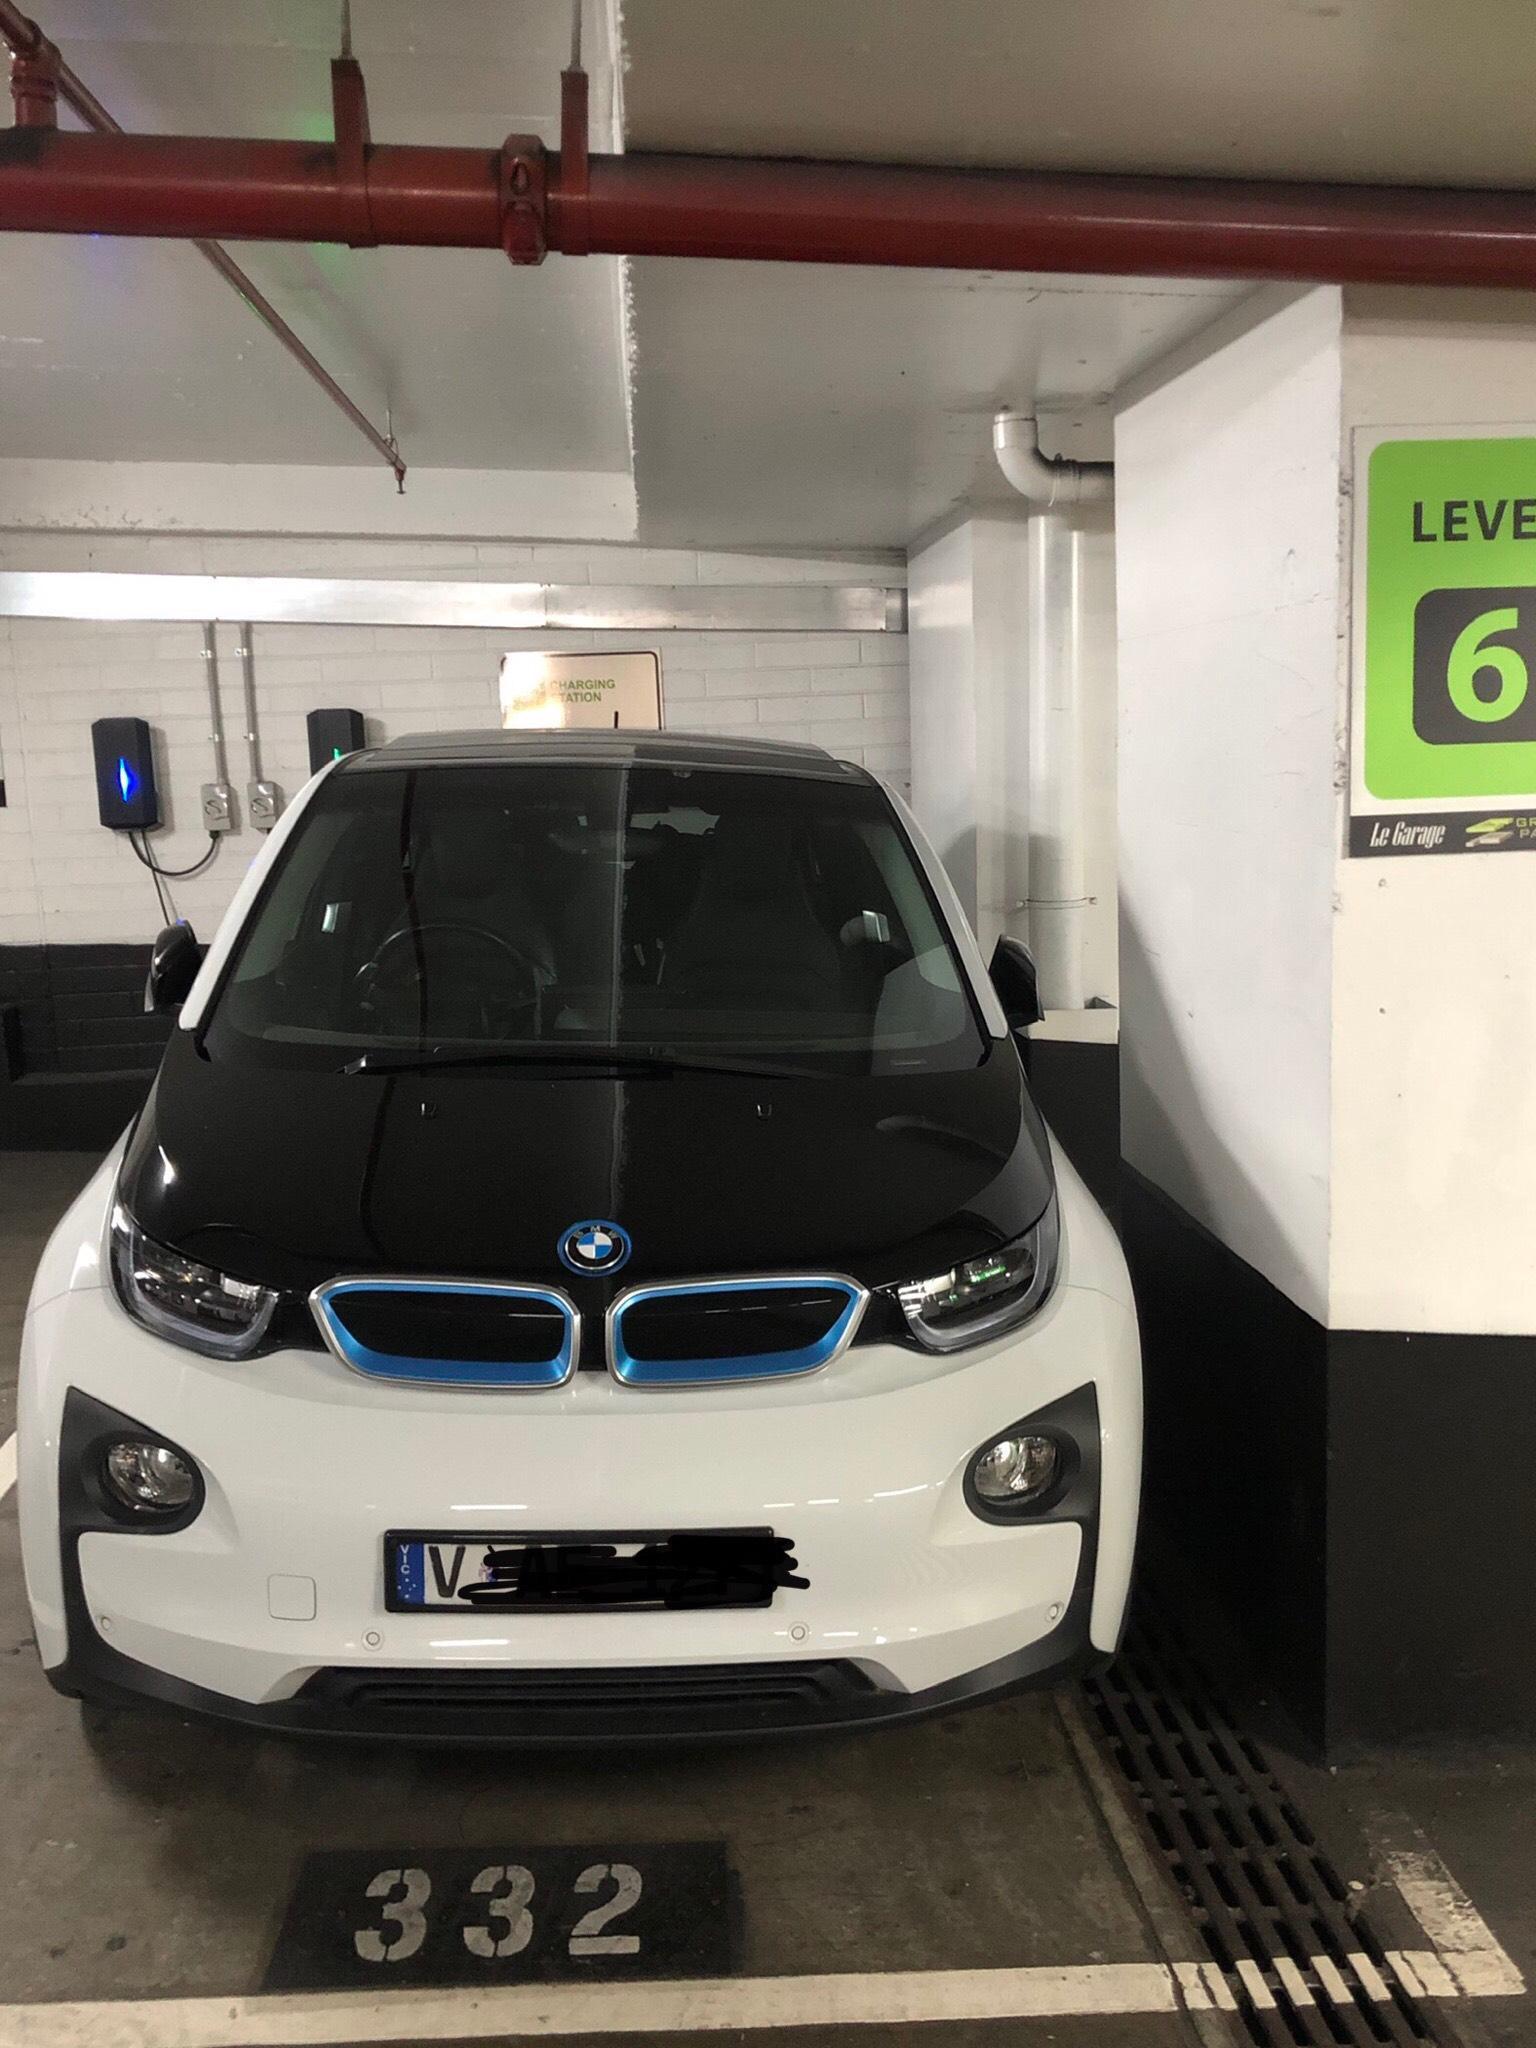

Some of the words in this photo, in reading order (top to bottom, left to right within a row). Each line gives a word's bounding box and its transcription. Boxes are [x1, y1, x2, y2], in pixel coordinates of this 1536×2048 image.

[1447, 607, 1528, 722] 6
[551, 691, 602, 702] TATION
[1369, 821, 1391, 847] Le
[1391, 820, 1446, 849] Garage
[400, 1544, 411, 1574] VIC
[354, 1863, 642, 1962] 332
